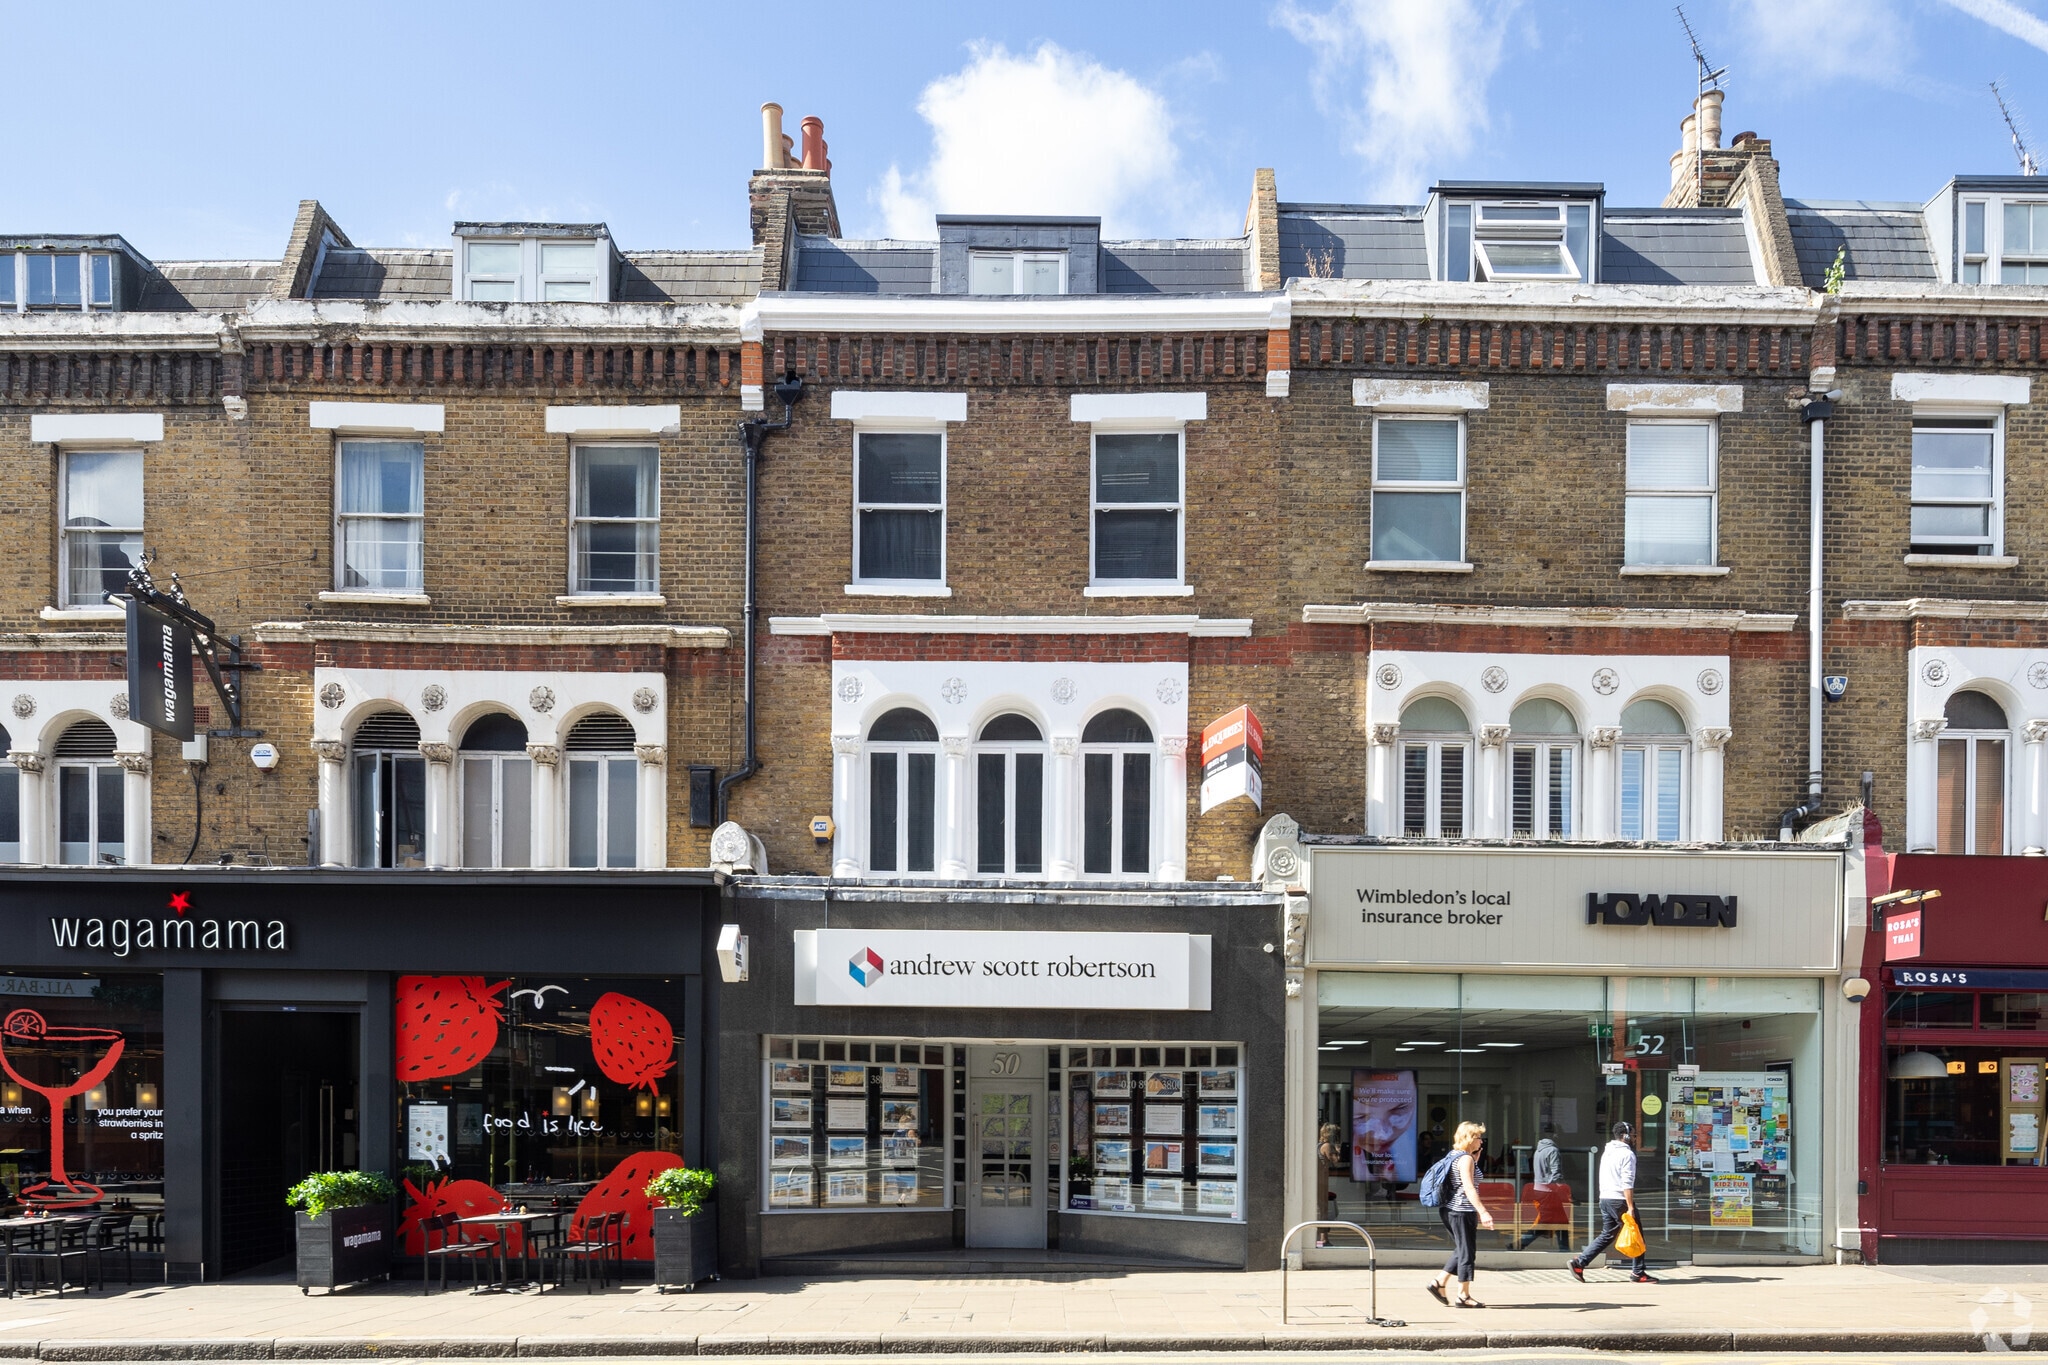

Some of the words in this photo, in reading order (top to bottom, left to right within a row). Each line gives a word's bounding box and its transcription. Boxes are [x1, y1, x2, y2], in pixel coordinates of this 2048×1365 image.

[162, 624, 176, 722] wagamama
[1356, 888, 1467, 905] Wimbledon's
[1471, 890, 1511, 906] local
[1361, 909, 1443, 925] insurance
[1447, 910, 1503, 926] broker
[1585, 892, 1738, 928] HOWDEN
[1887, 917, 1920, 932] ROSA'S
[51, 918, 285, 957] wagamama
[1892, 932, 1914, 945] THAI
[890, 953, 976, 976] andrew
[982, 958, 1040, 977] scott
[1047, 955, 1156, 979] robertson
[1902, 972, 1967, 984] ROSA'S
[1636, 1035, 1665, 1054] 52
[990, 1052, 1020, 1076] 50
[1376, 1087, 1395, 1095] make
[1378, 1096, 1412, 1104] protected
[8, 1106, 32, 1114] when
[97, 1109, 115, 1118] you
[116, 1107, 143, 1117] prefer
[144, 1109, 164, 1118] your
[99, 1118, 153, 1128] strawberries
[154, 1119, 164, 1128] in
[482, 1111, 531, 1134] food
[542, 1115, 559, 1134] is
[130, 1132, 137, 1140] a
[139, 1131, 164, 1141] spritz
[343, 1230, 382, 1248] wagamama
